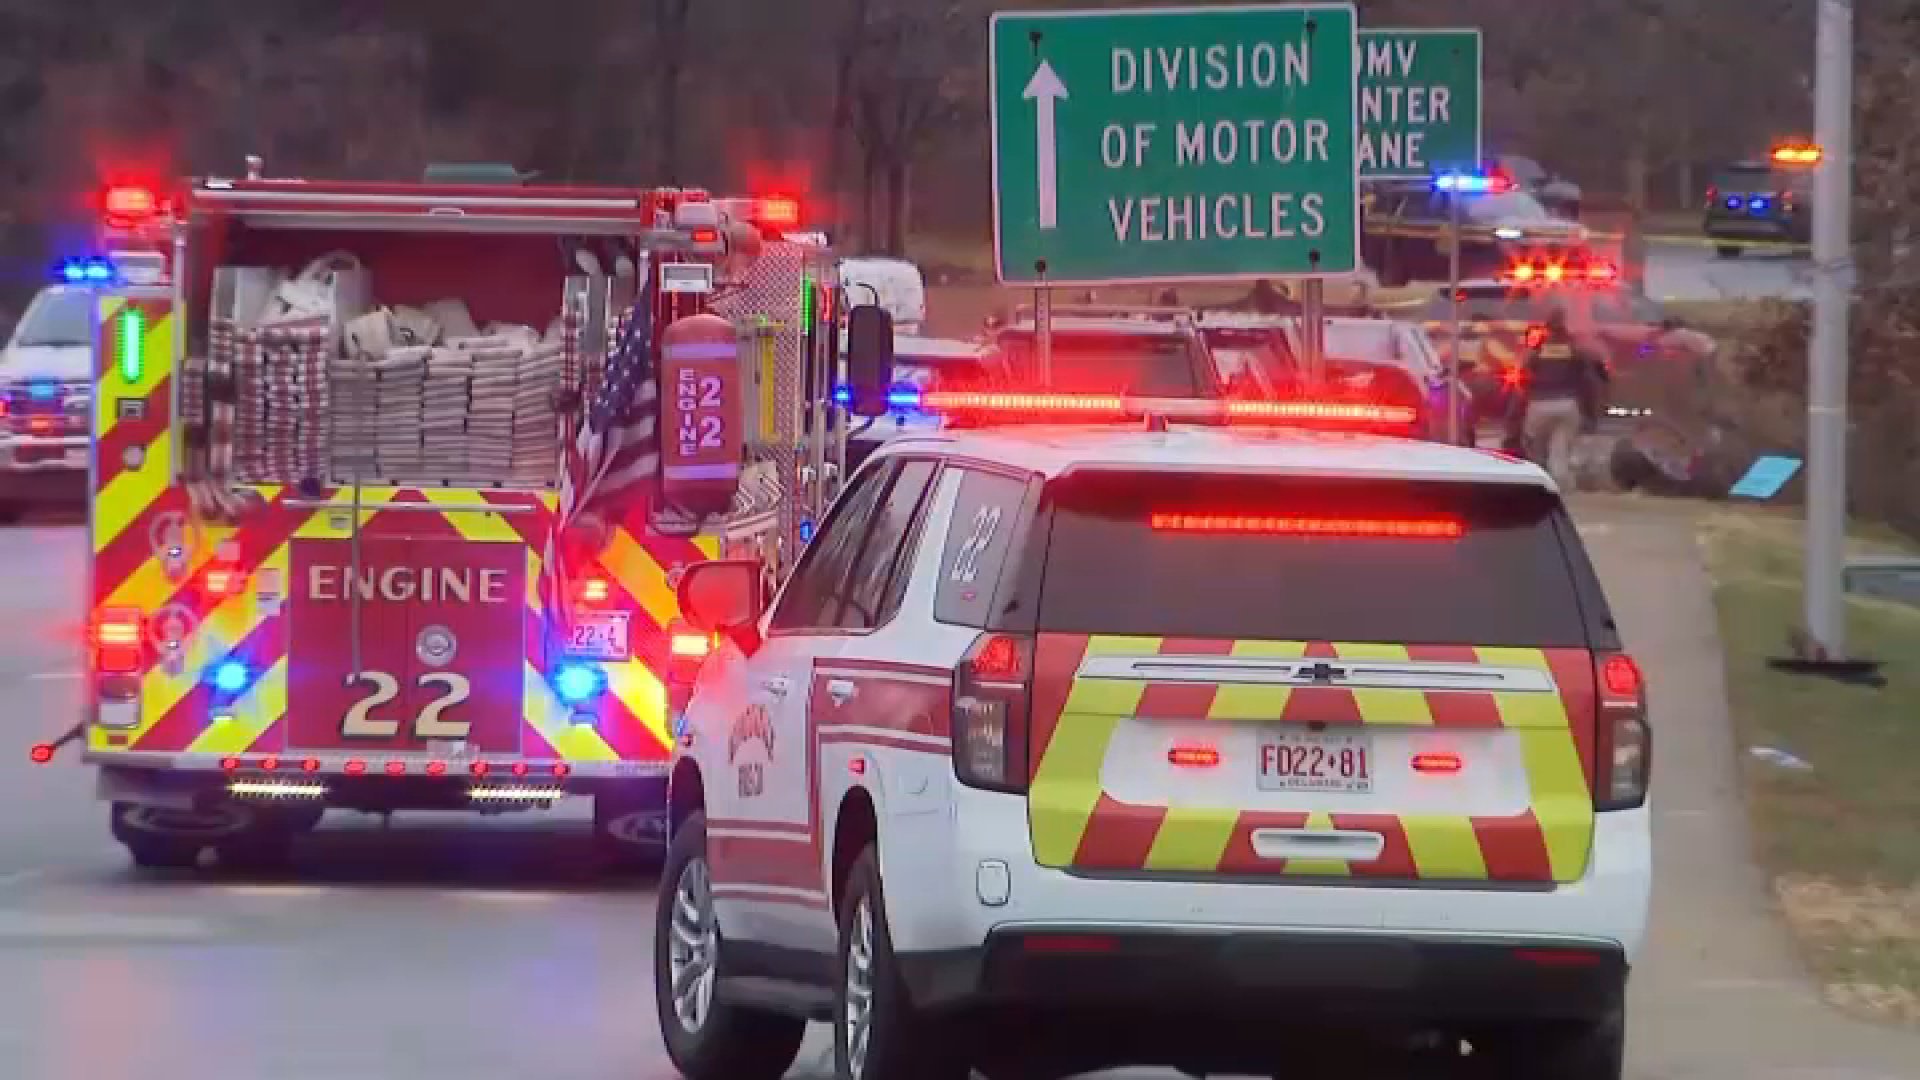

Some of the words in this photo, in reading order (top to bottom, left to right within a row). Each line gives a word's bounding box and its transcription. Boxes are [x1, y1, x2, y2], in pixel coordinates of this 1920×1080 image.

[1111, 42, 1310, 93] DIVISION
[1361, 85, 1451, 124] NTER
[1102, 123, 1157, 168] OF
[1176, 119, 1330, 166] MOTOR
[1359, 132, 1425, 169] ANE
[1108, 193, 1326, 243] VEHICLES
[678, 368, 697, 457] ENGINE
[308, 565, 508, 604] ENGINE
[342, 671, 471, 738] 22
